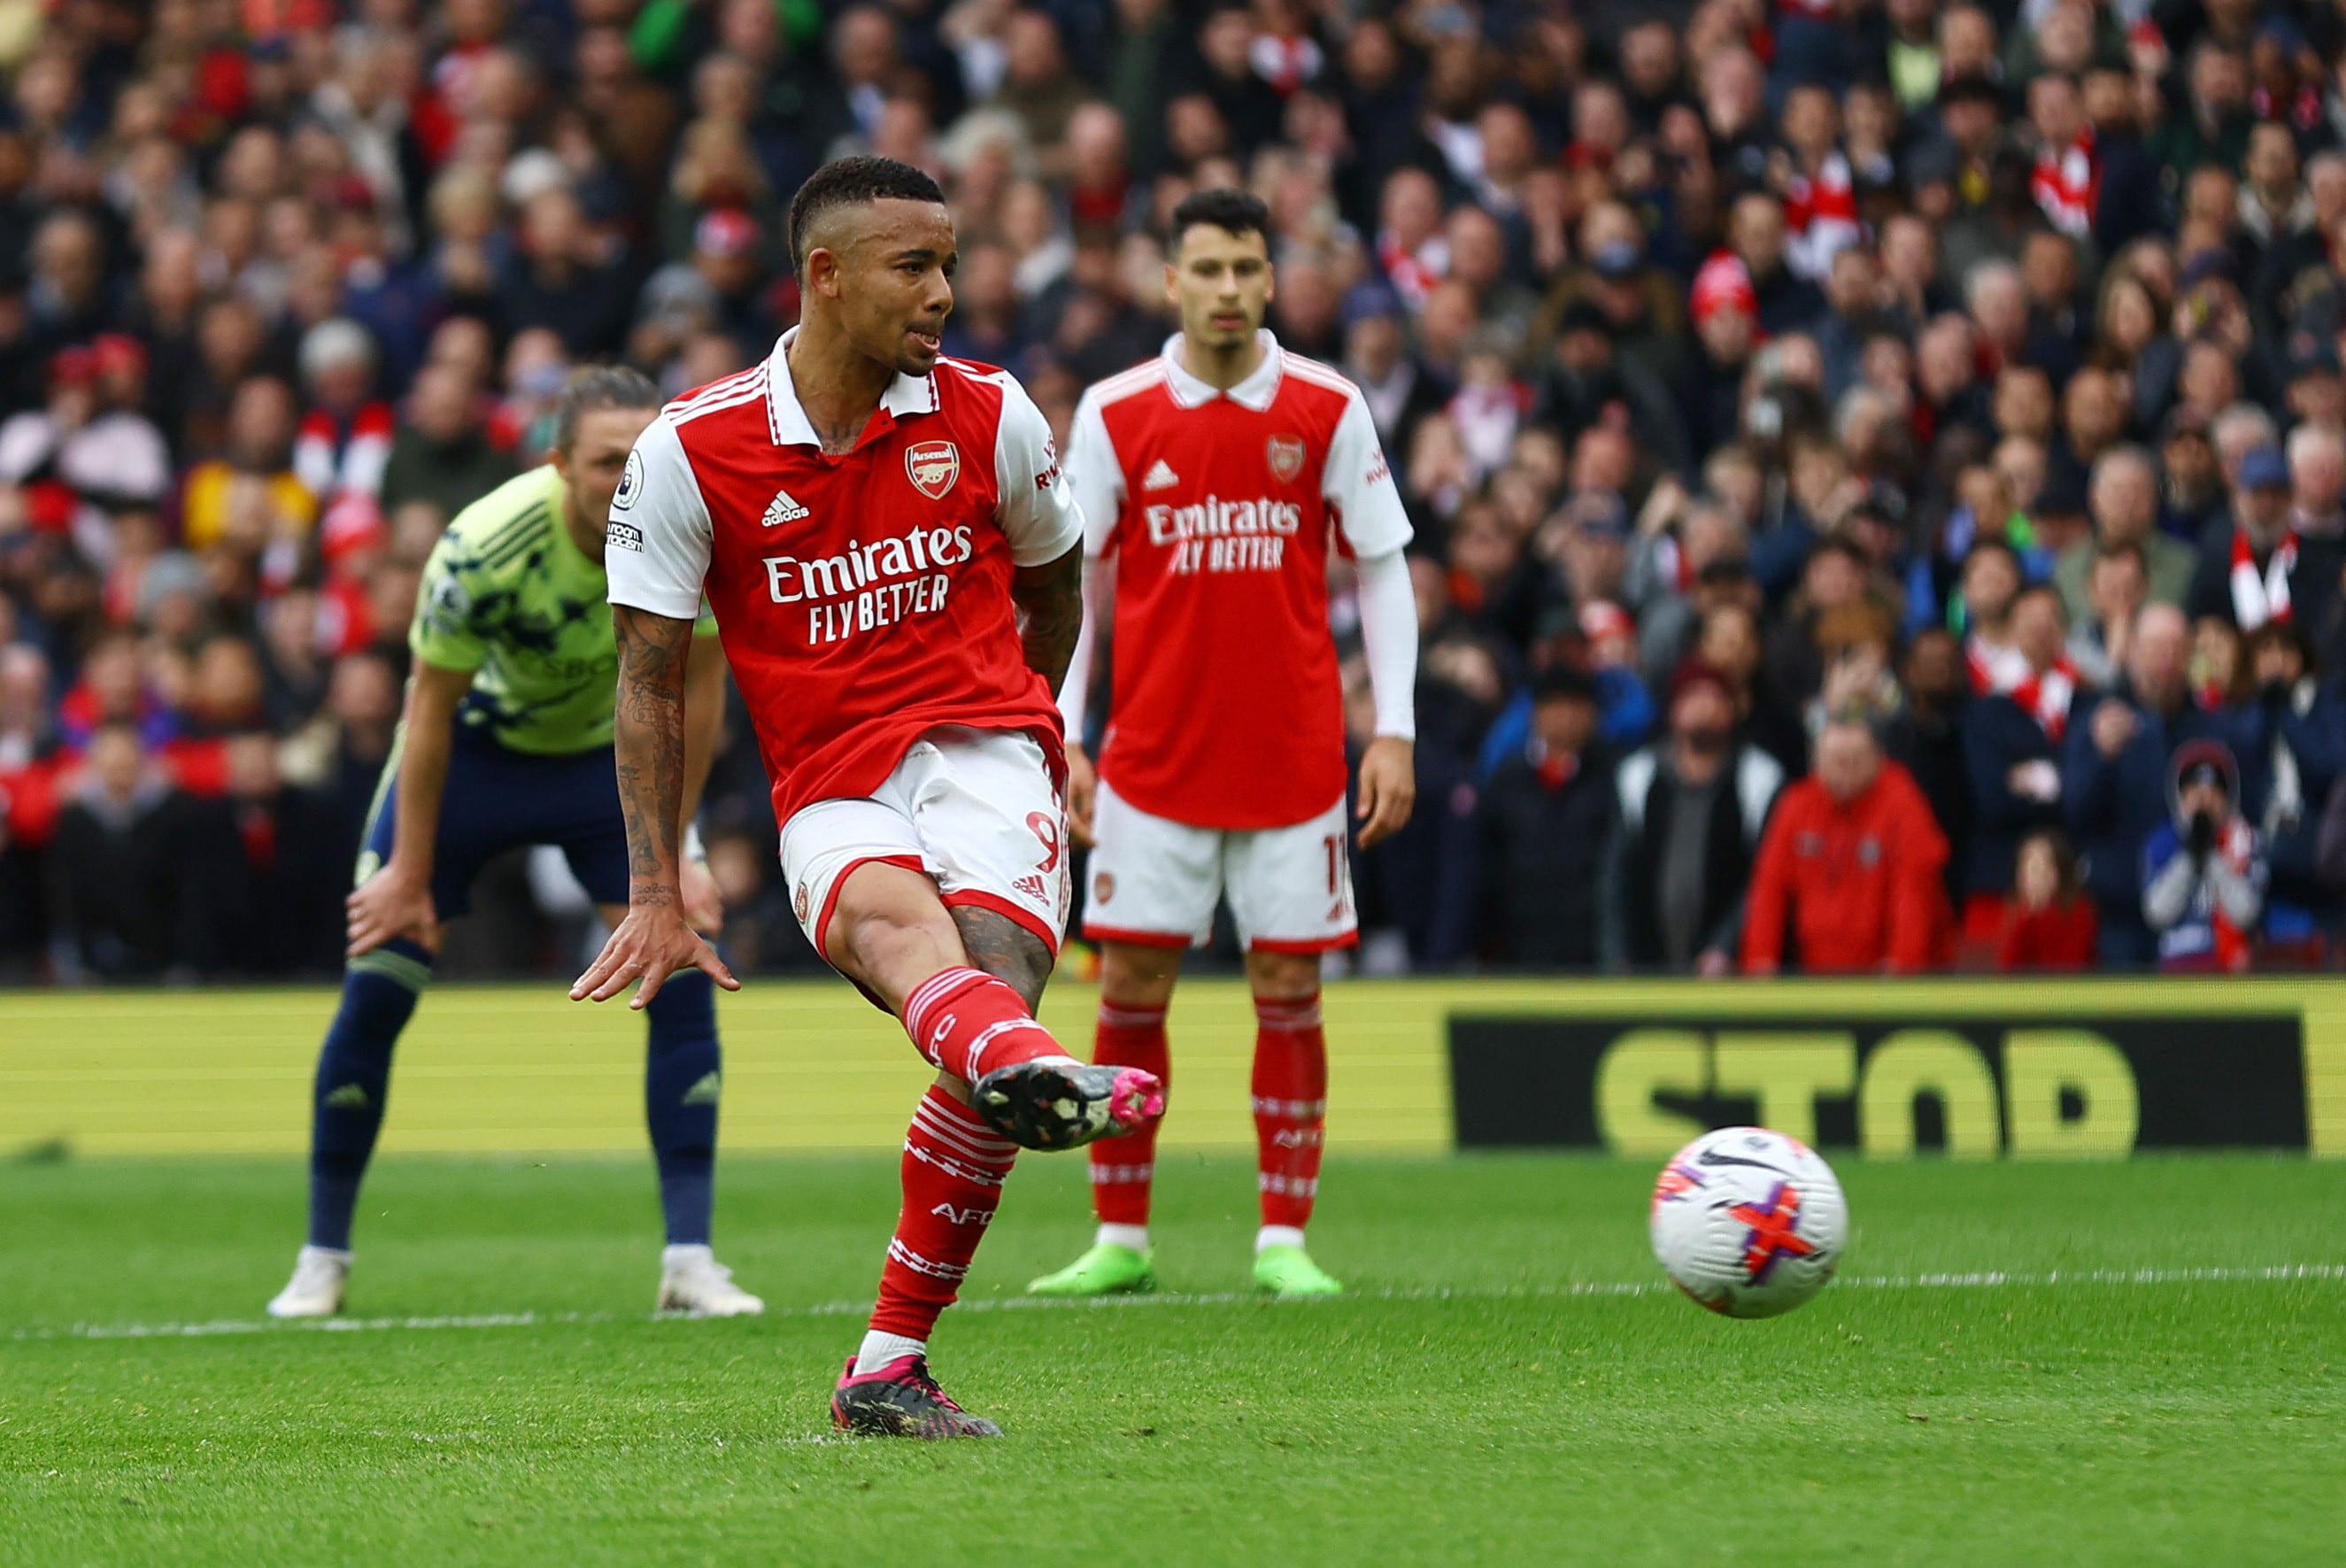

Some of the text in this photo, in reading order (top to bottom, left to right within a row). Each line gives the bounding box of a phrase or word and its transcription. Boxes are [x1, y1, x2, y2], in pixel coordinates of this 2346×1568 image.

[913, 449, 951, 461] Arsenal
[761, 506, 810, 527] adidas
[1146, 493, 1301, 546] Emirates
[761, 525, 972, 603] Emirates
[1025, 810, 1059, 875] 9
